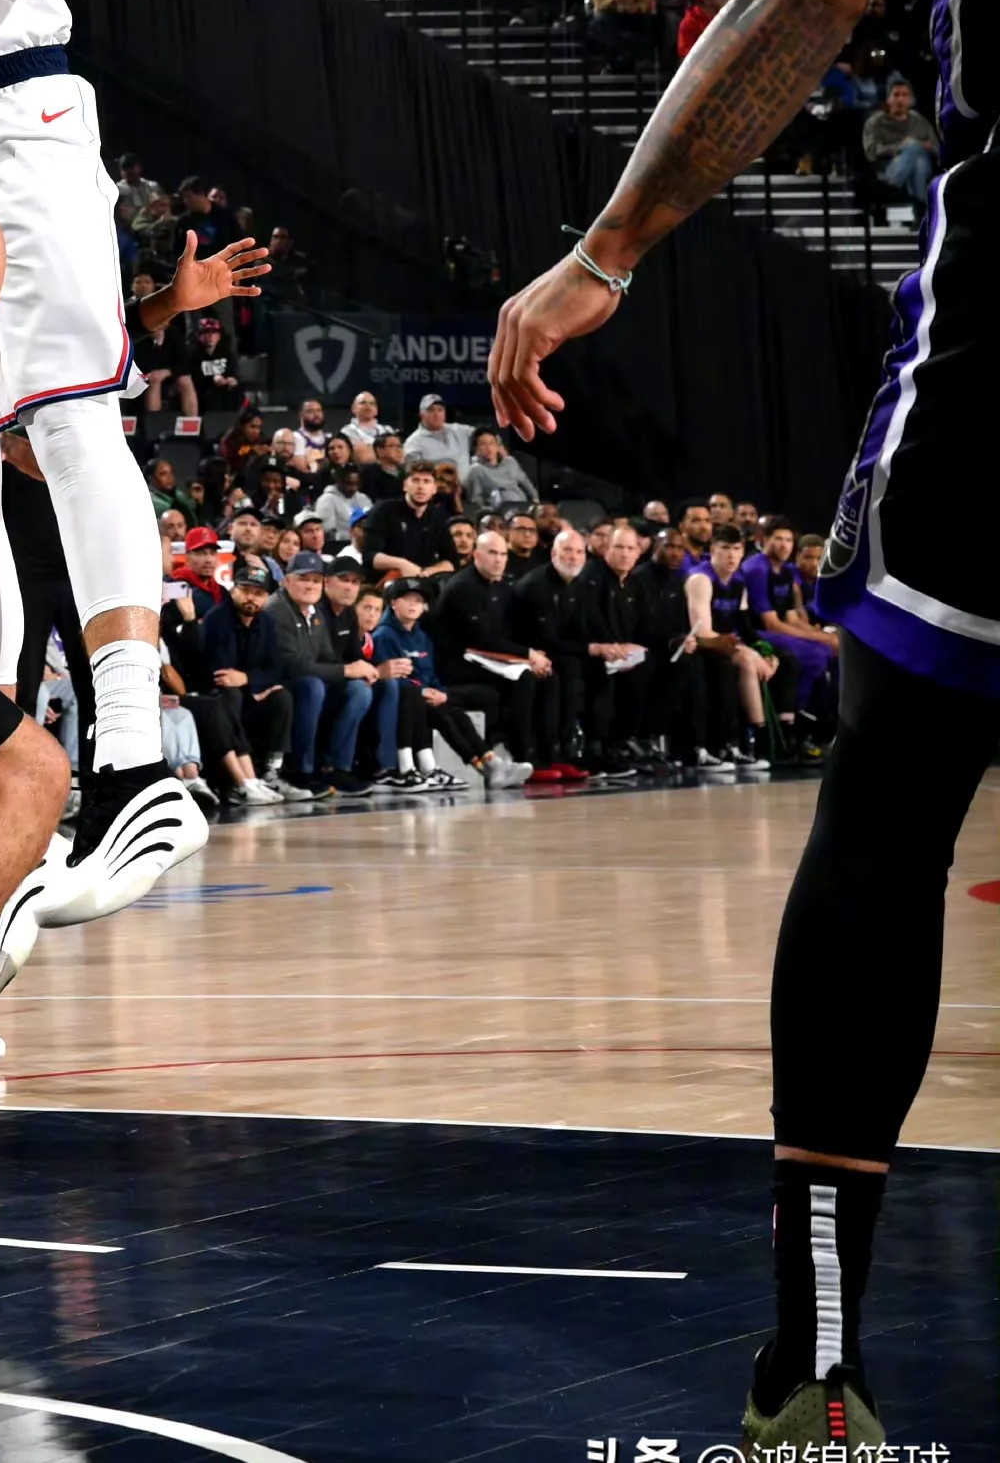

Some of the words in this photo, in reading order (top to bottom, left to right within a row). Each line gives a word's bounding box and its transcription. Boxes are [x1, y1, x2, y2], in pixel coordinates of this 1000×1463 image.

[369, 334, 496, 363] FANDUE
[369, 367, 431, 385] SPORTS
[433, 368, 490, 385] NETWO
